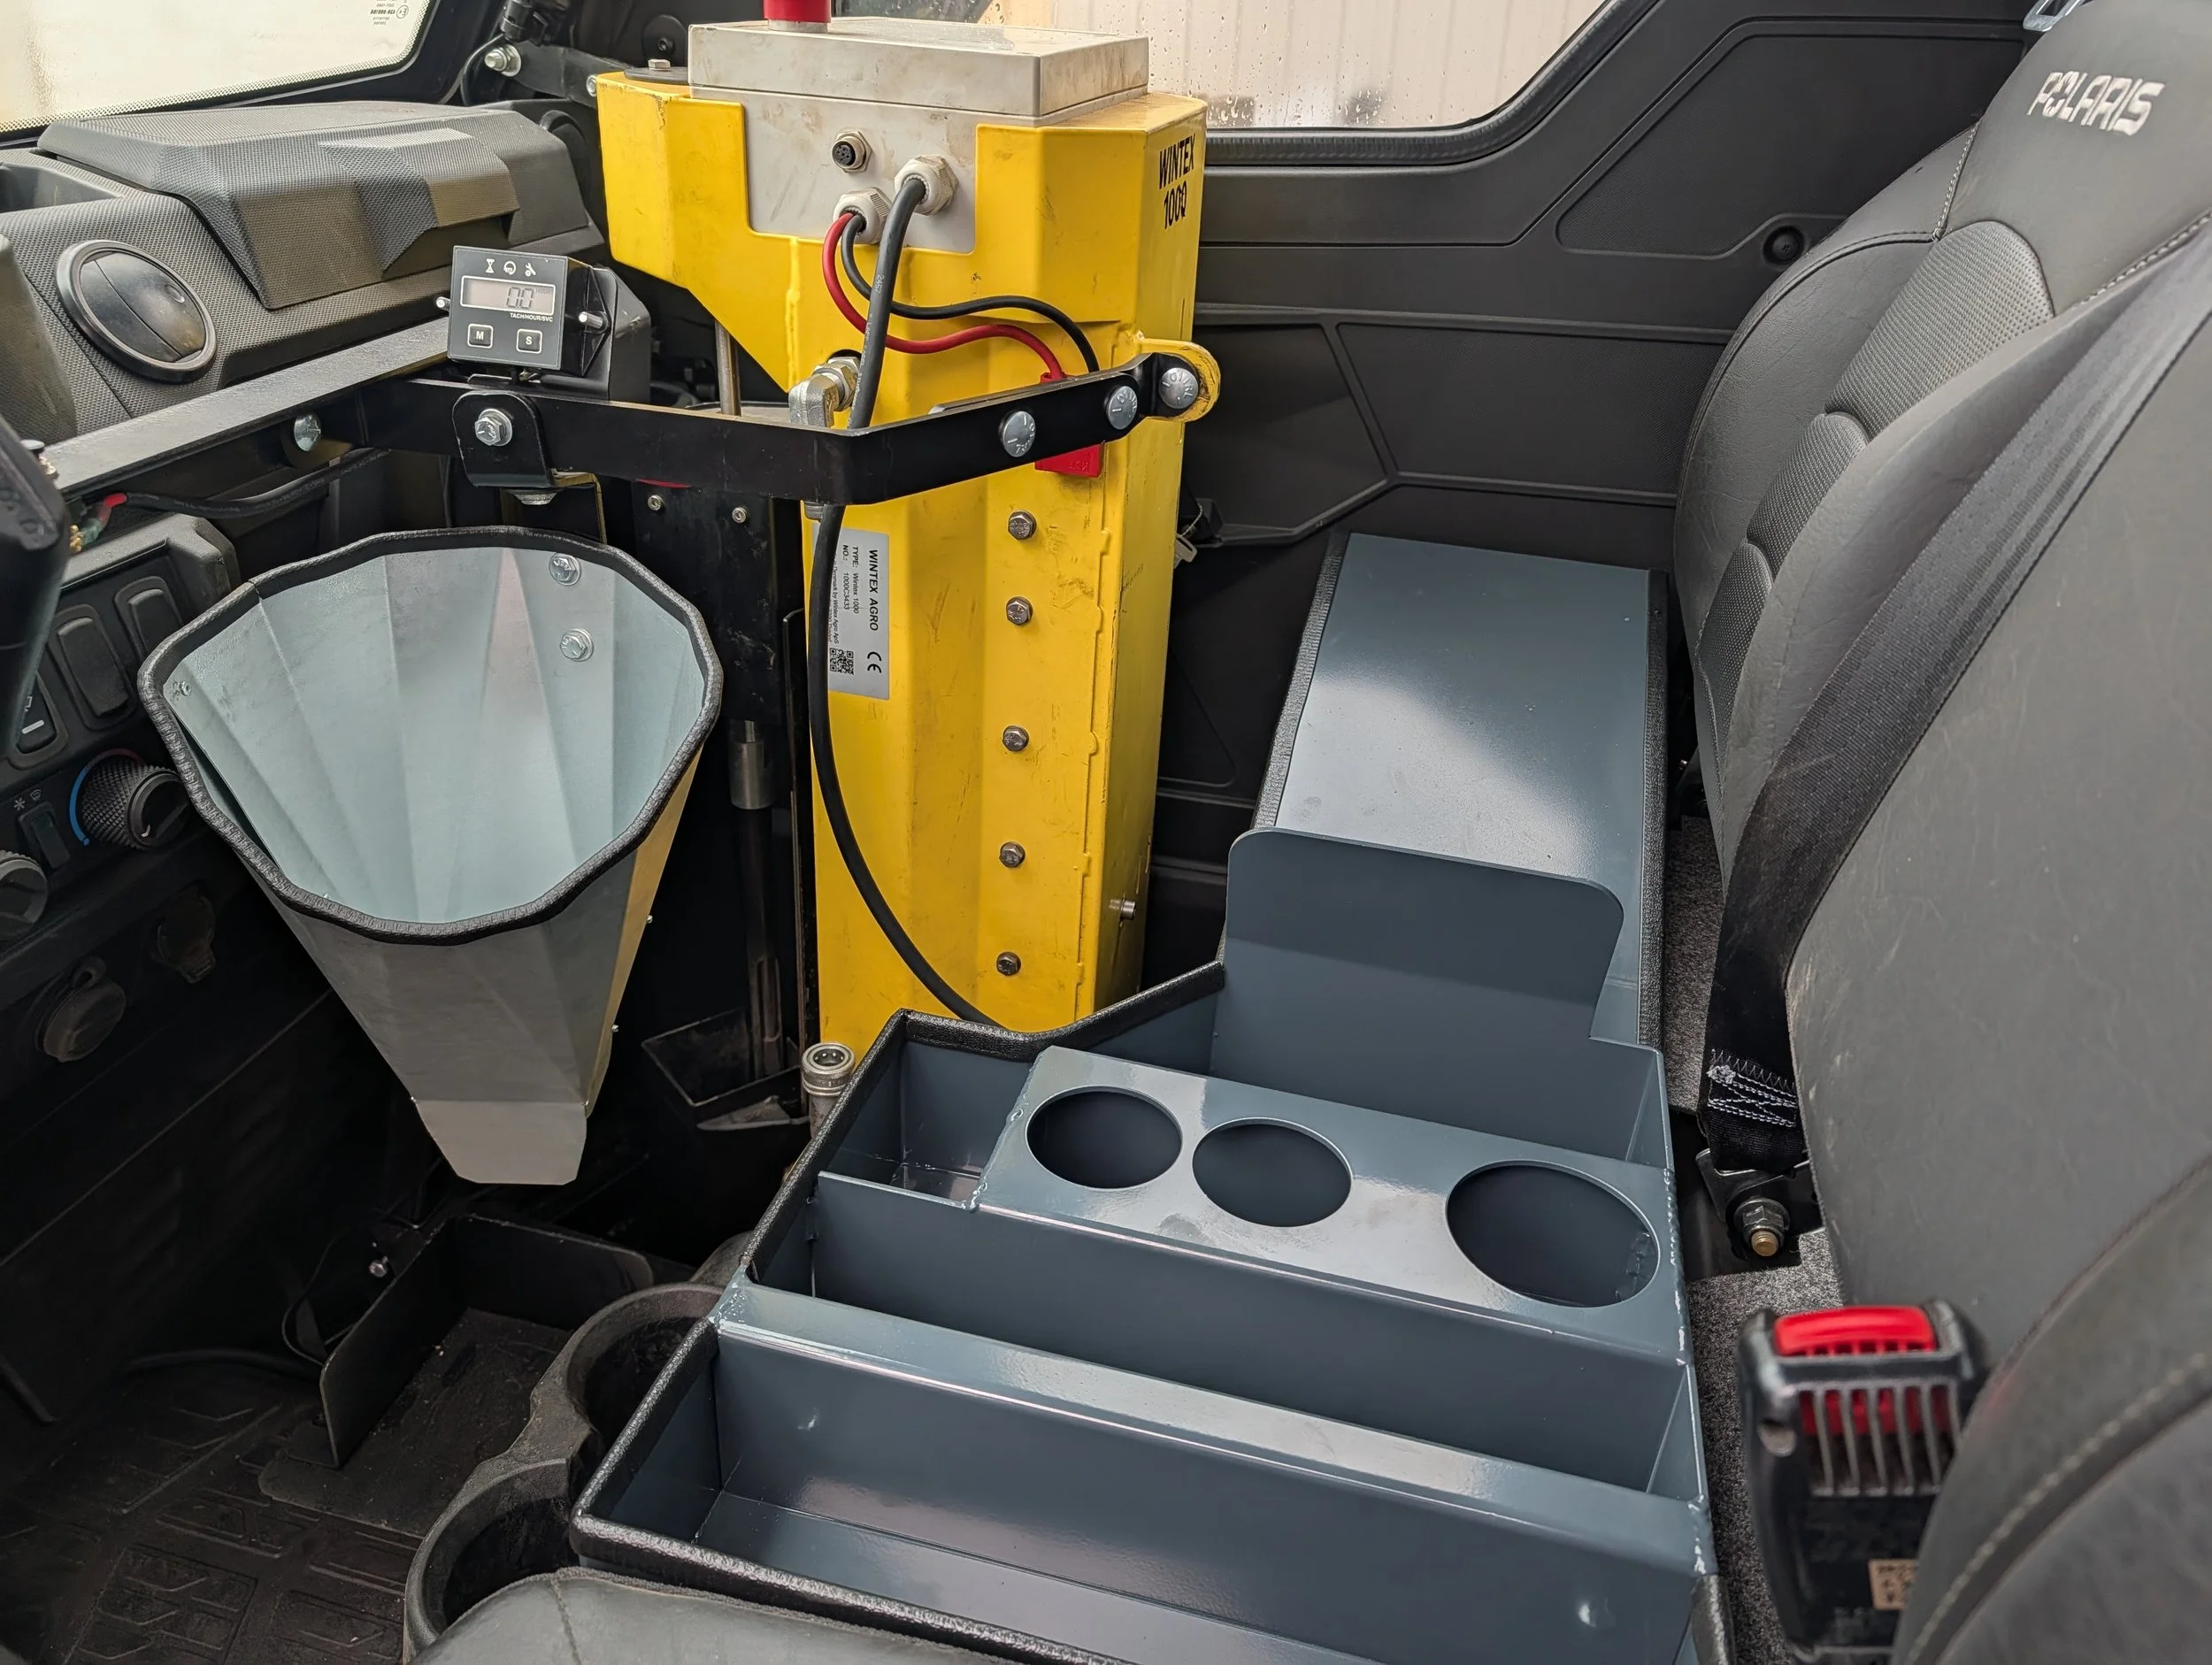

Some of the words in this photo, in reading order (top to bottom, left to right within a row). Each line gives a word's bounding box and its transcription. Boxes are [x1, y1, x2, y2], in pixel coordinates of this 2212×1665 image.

[2026, 70, 2166, 136] POLARIS
[1159, 133, 1196, 189] WINTEX
[510, 312, 553, 323] TACH/HOUR/SVC
[475, 331, 484, 341] M
[526, 335, 533, 345] S
[869, 549, 879, 594] WINTEX
[869, 598, 879, 631] AGRO
